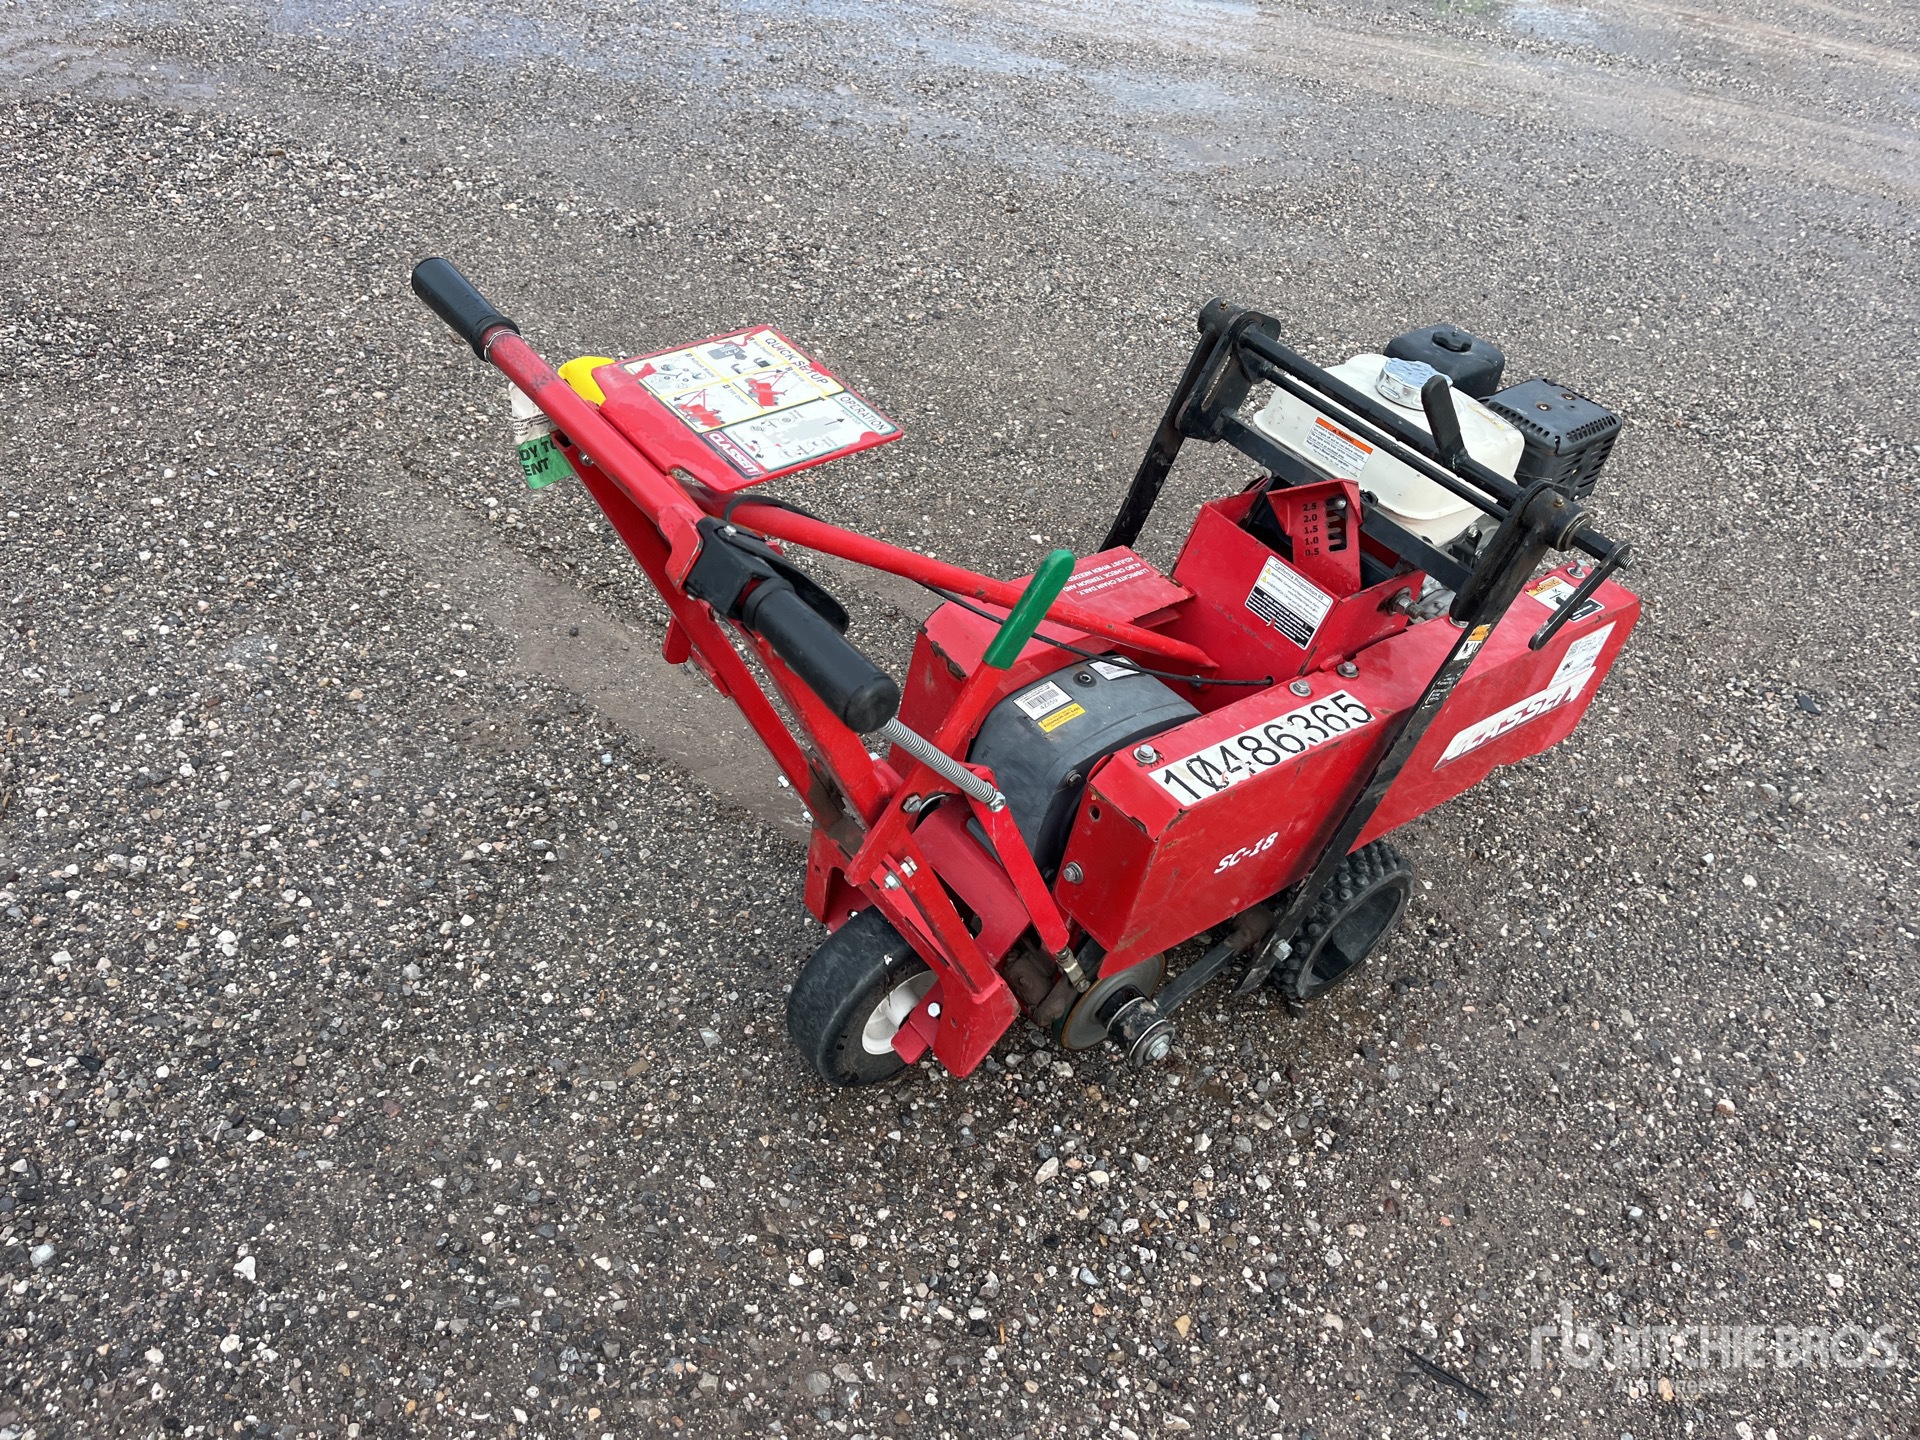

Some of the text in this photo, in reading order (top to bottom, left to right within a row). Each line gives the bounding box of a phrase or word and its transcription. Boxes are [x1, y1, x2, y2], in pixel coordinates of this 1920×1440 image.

[765, 337, 829, 384] QUICK SETUP
[840, 395, 888, 431] OPERATION
[1303, 502, 1317, 511] 2.5
[1303, 513, 1318, 523] 2.0
[1304, 525, 1318, 534] 1.5
[1305, 536, 1319, 546] 1.0
[1305, 547, 1319, 557] 0.5
[1111, 556, 1134, 568] ADJUST
[1091, 564, 1112, 574] WHEN
[1062, 562, 1142, 592] ALSO CHECK TENSION AND
[1117, 568, 1150, 583] LUBRICATE
[1096, 579, 1117, 590] CHAIN
[1274, 563, 1324, 601] California Proposition 65
[1213, 831, 1279, 874] SC-18
